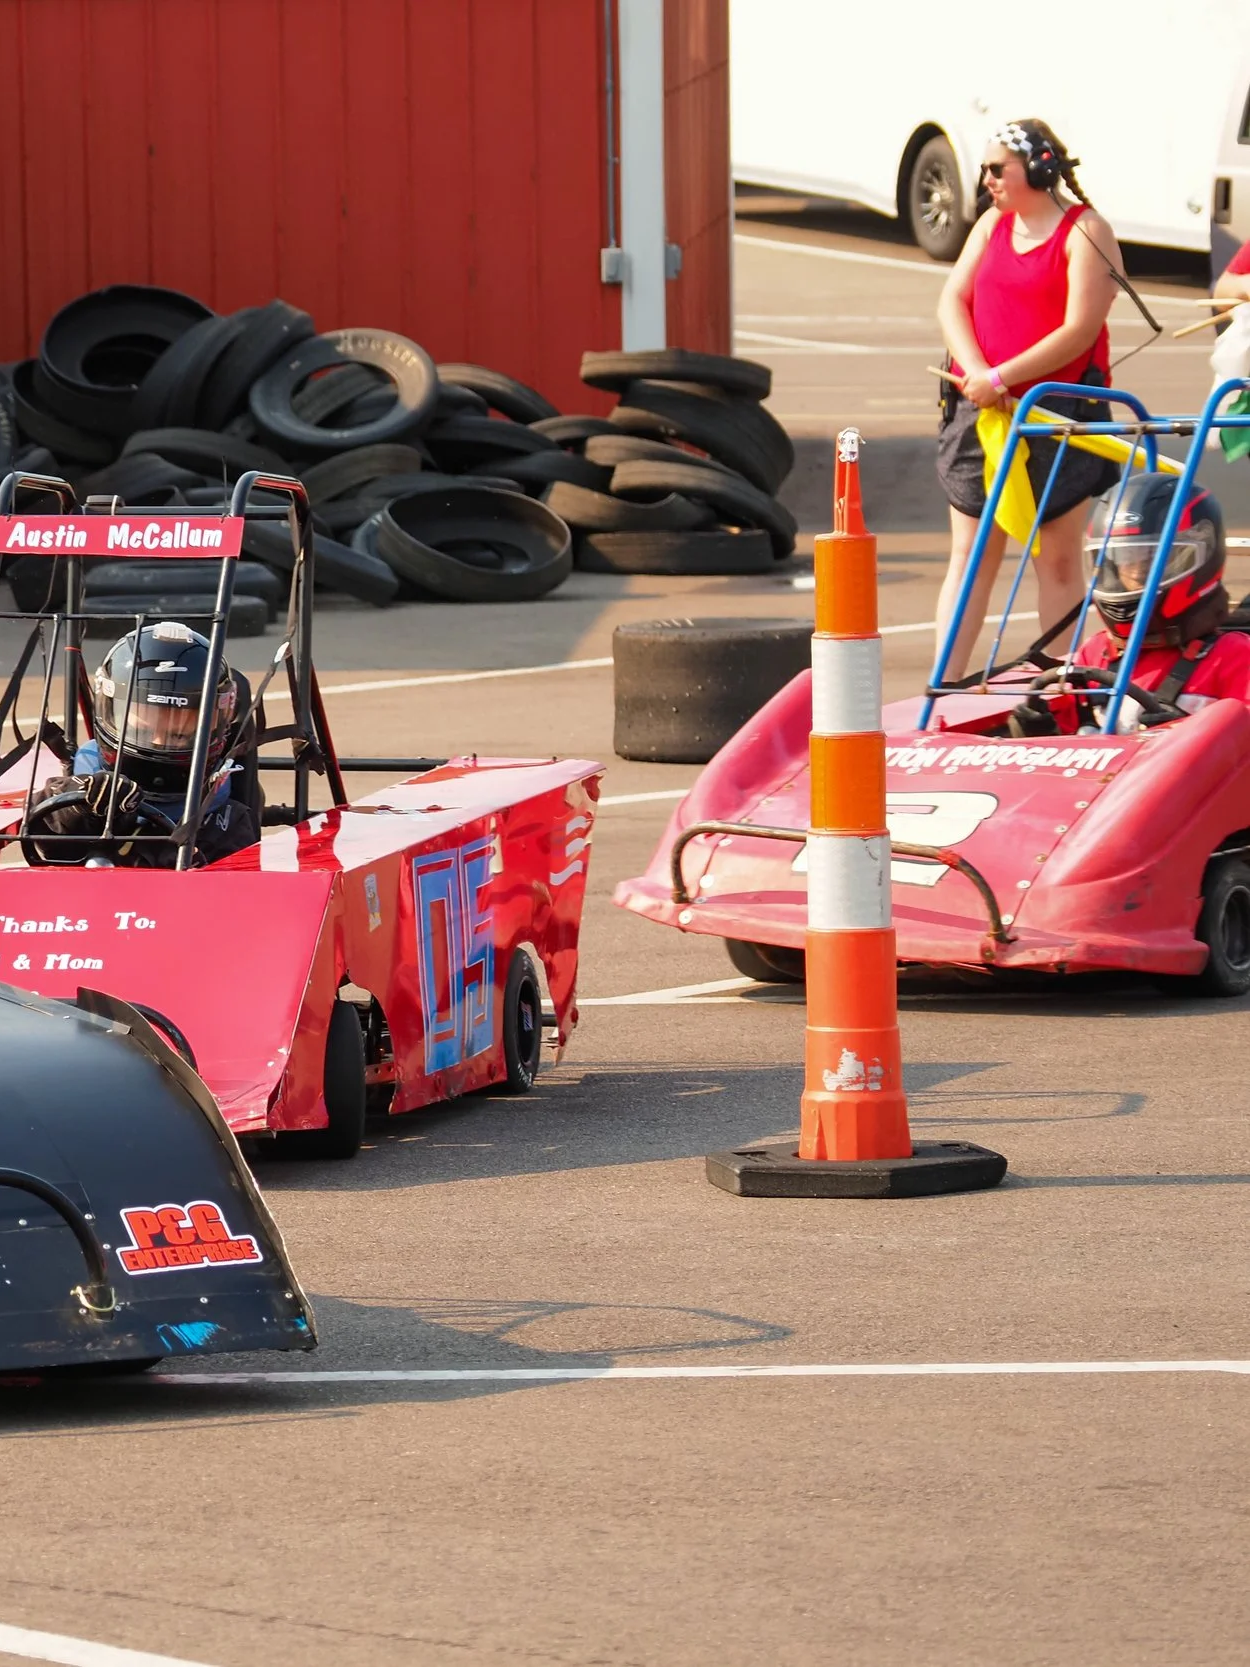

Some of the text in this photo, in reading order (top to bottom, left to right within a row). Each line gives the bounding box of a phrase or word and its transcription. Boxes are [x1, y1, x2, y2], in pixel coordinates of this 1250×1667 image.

[6, 521, 223, 549] Austin McCallum
[146, 694, 189, 707] zamp
[938, 745, 1125, 771] PHOTOGRAPHY
[114, 911, 157, 930] To:
[12, 953, 31, 970] &
[43, 953, 104, 971] Mom
[120, 1238, 259, 1272] ENTERPRISE
